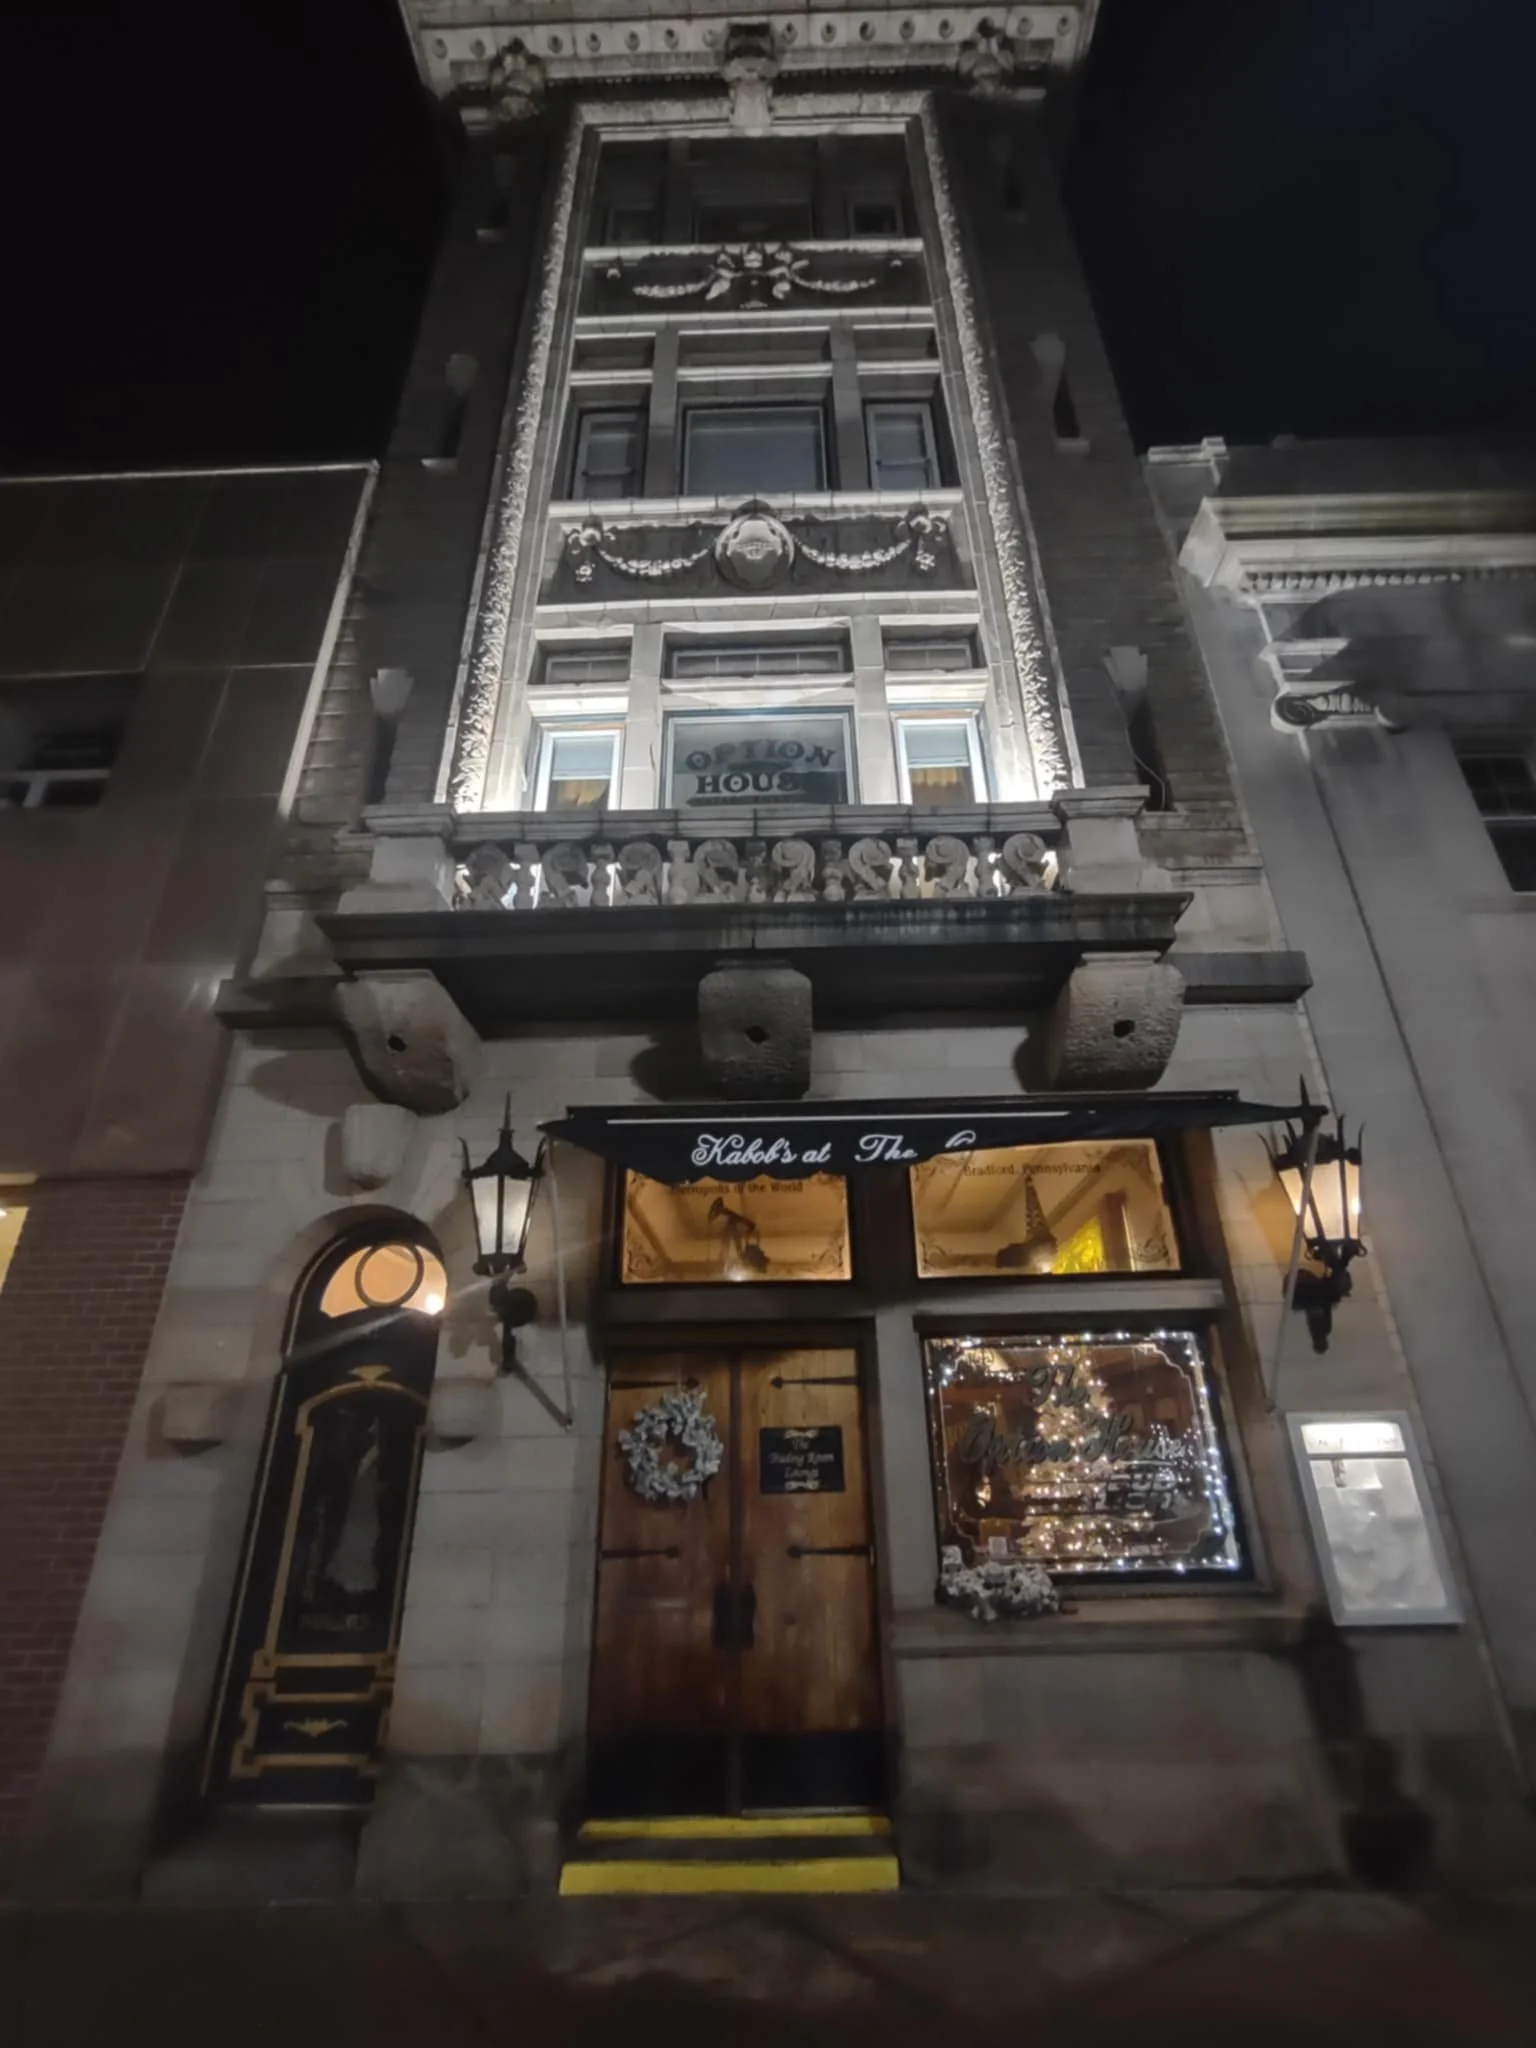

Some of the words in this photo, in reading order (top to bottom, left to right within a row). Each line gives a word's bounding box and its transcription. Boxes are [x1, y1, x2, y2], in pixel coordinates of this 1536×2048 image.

[685, 738, 835, 771] OPTION
[696, 772, 803, 794] HOUS
[690, 1133, 799, 1167] Kabob's
[801, 1142, 832, 1163] at
[854, 1133, 920, 1162] The
